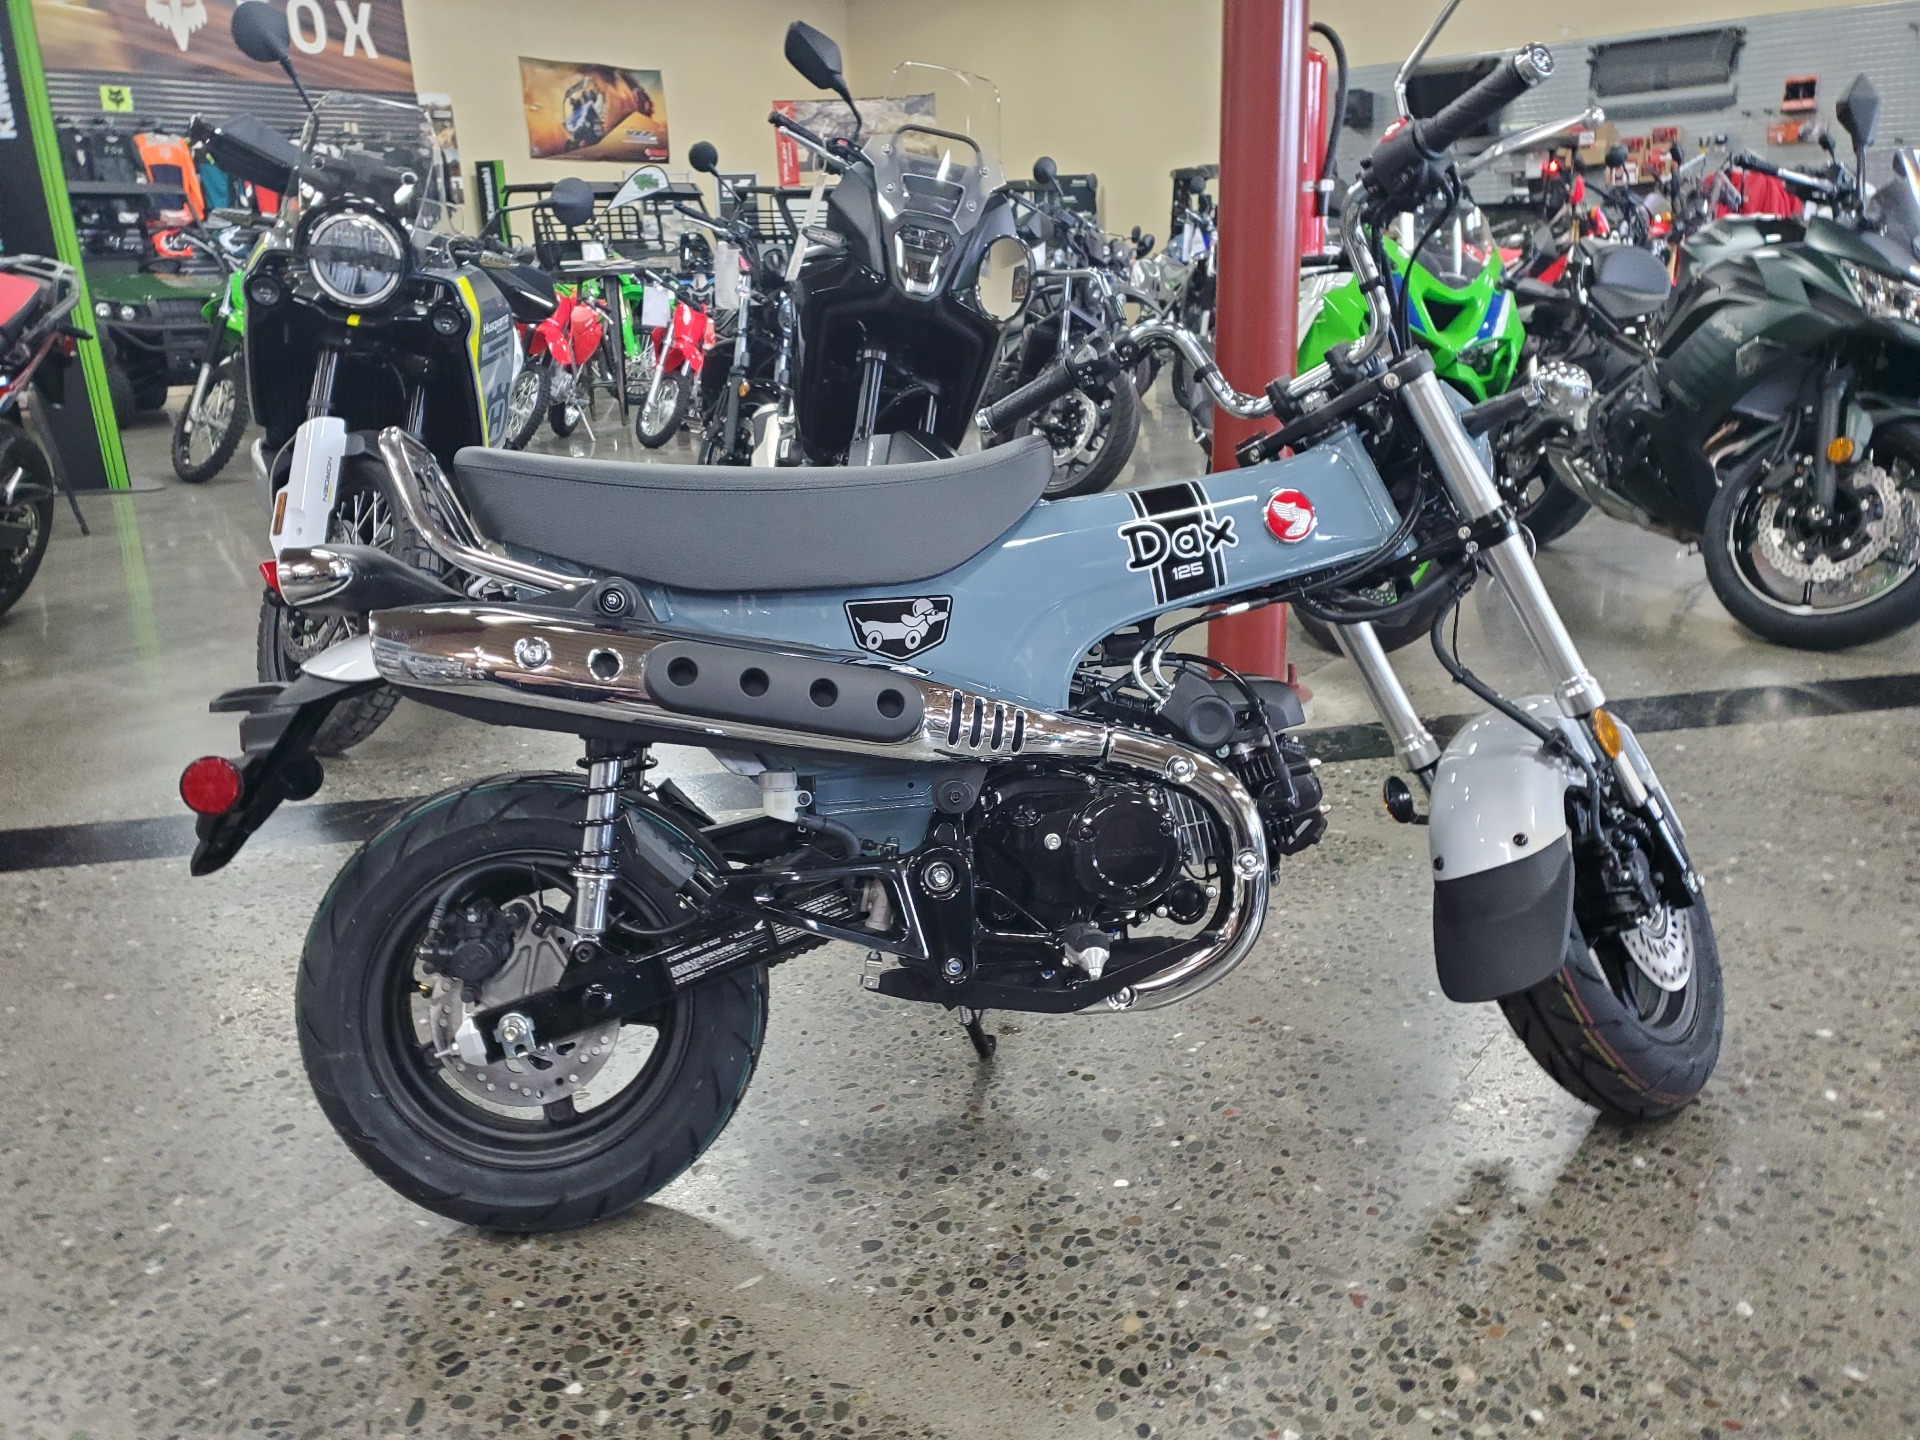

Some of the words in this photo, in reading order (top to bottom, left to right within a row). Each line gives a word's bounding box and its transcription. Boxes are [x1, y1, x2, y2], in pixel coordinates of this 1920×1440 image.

[237, 0, 379, 59] OX
[483, 314, 510, 336] Husqvarna
[322, 456, 333, 502] NORDEN
[1117, 515, 1239, 573] Dax
[1171, 561, 1205, 581] 125
